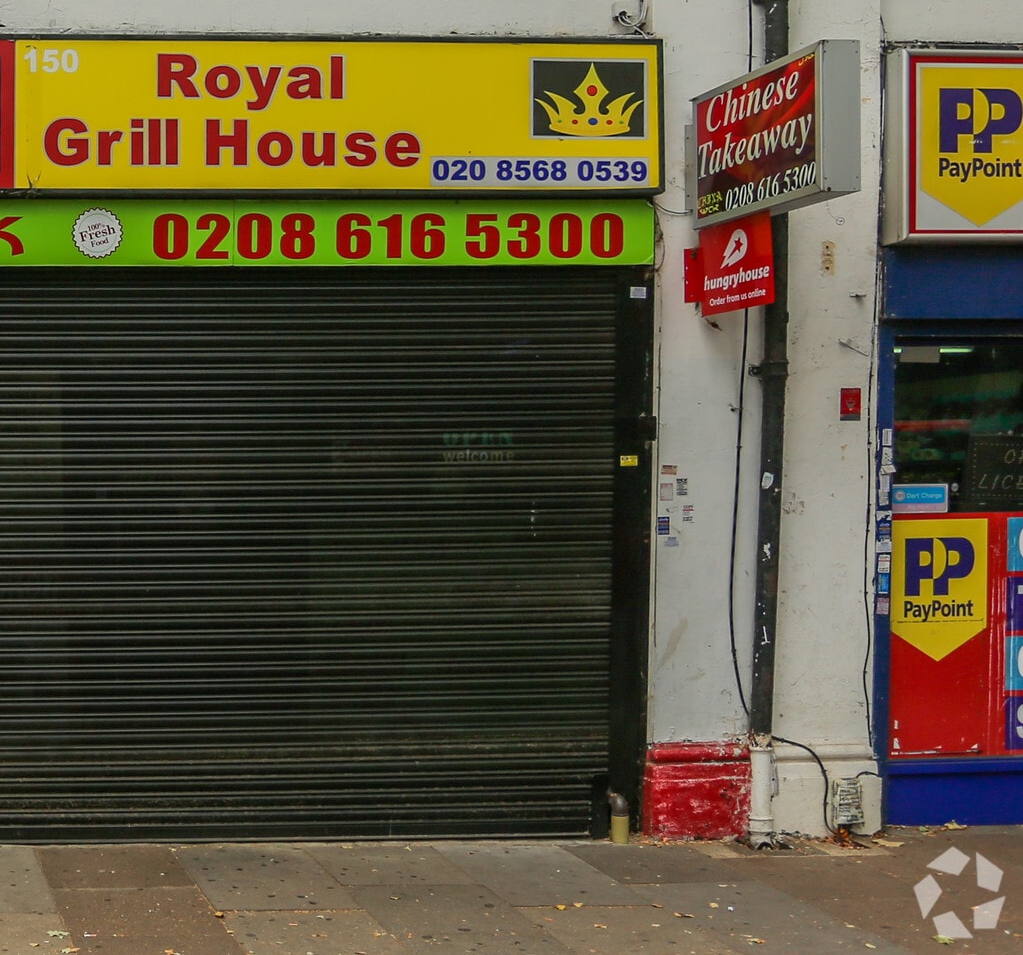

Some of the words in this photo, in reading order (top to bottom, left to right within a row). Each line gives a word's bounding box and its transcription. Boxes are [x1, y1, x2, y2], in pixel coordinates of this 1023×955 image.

[23, 48, 79, 73] 150
[156, 52, 346, 111] Royal
[705, 71, 799, 132] Chinese
[43, 117, 180, 167] Grill
[203, 118, 423, 168] House
[698, 113, 812, 179] Takeaway
[432, 159, 486, 182] 020
[495, 159, 568, 182] 8568
[577, 159, 648, 183] 0539
[938, 158, 1022, 183] PayPoint
[725, 181, 755, 211] 0208
[757, 172, 780, 203] 616
[783, 161, 816, 191] 5300
[79, 225, 116, 242] Fresh
[90, 237, 109, 248] Food
[152, 213, 316, 260] 0208
[336, 213, 446, 259] 616
[465, 213, 624, 259] 5300
[703, 265, 770, 291] hungryhouse
[709, 297, 725, 307] Order
[726, 293, 740, 304] from
[740, 292, 748, 300] us
[747, 288, 766, 298] online
[442, 449, 514, 462] welcome
[903, 599, 974, 622] PayPoint
